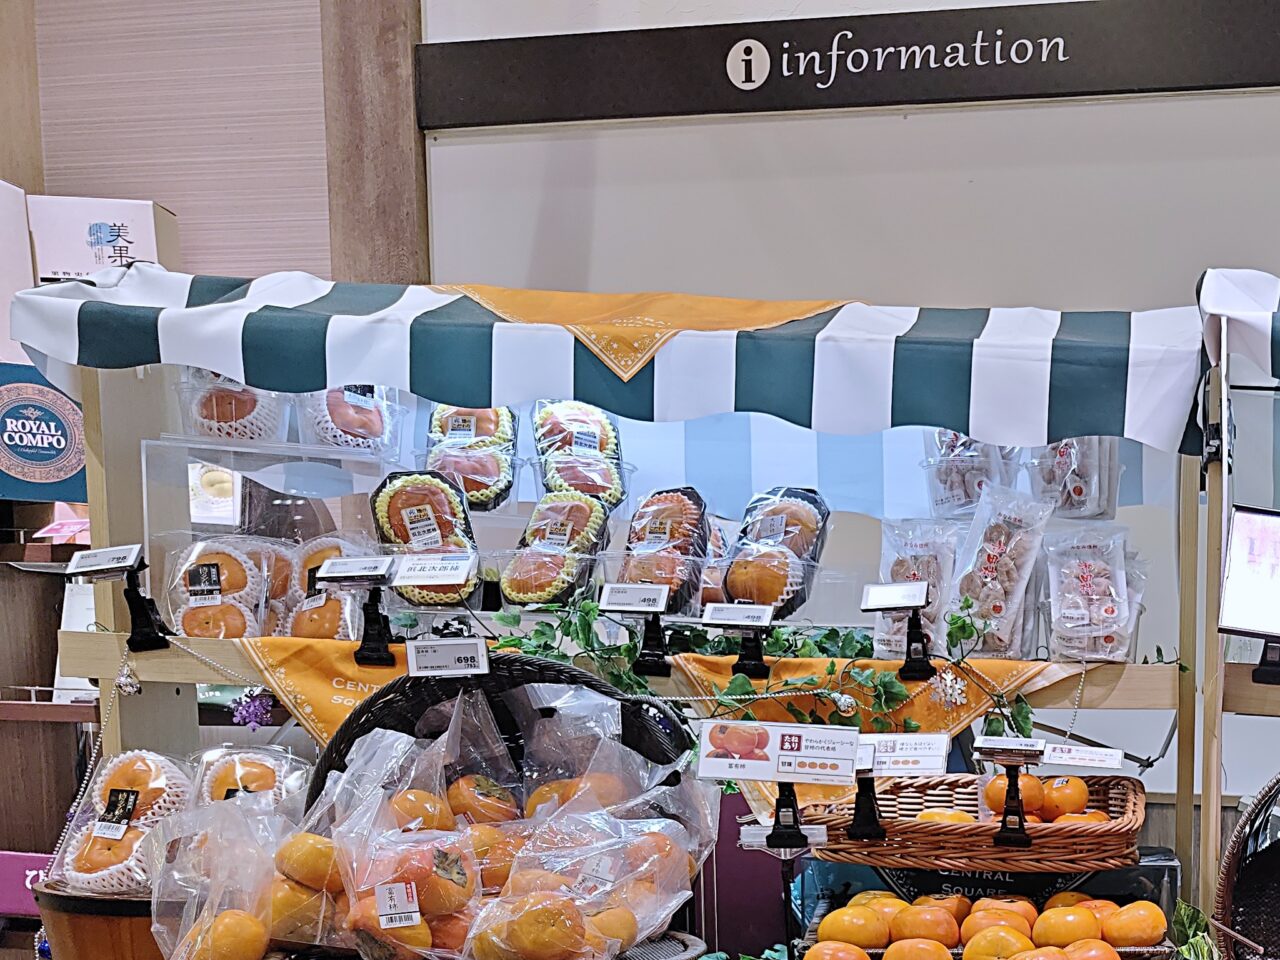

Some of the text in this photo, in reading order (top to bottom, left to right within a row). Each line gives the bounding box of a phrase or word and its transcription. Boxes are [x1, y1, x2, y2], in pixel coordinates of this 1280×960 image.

[780, 29, 1070, 89] information
[5, 417, 61, 436] ROYAL
[3, 432, 66, 449] COMPO
[456, 656, 476, 664] 698
[332, 677, 381, 693] CENT
